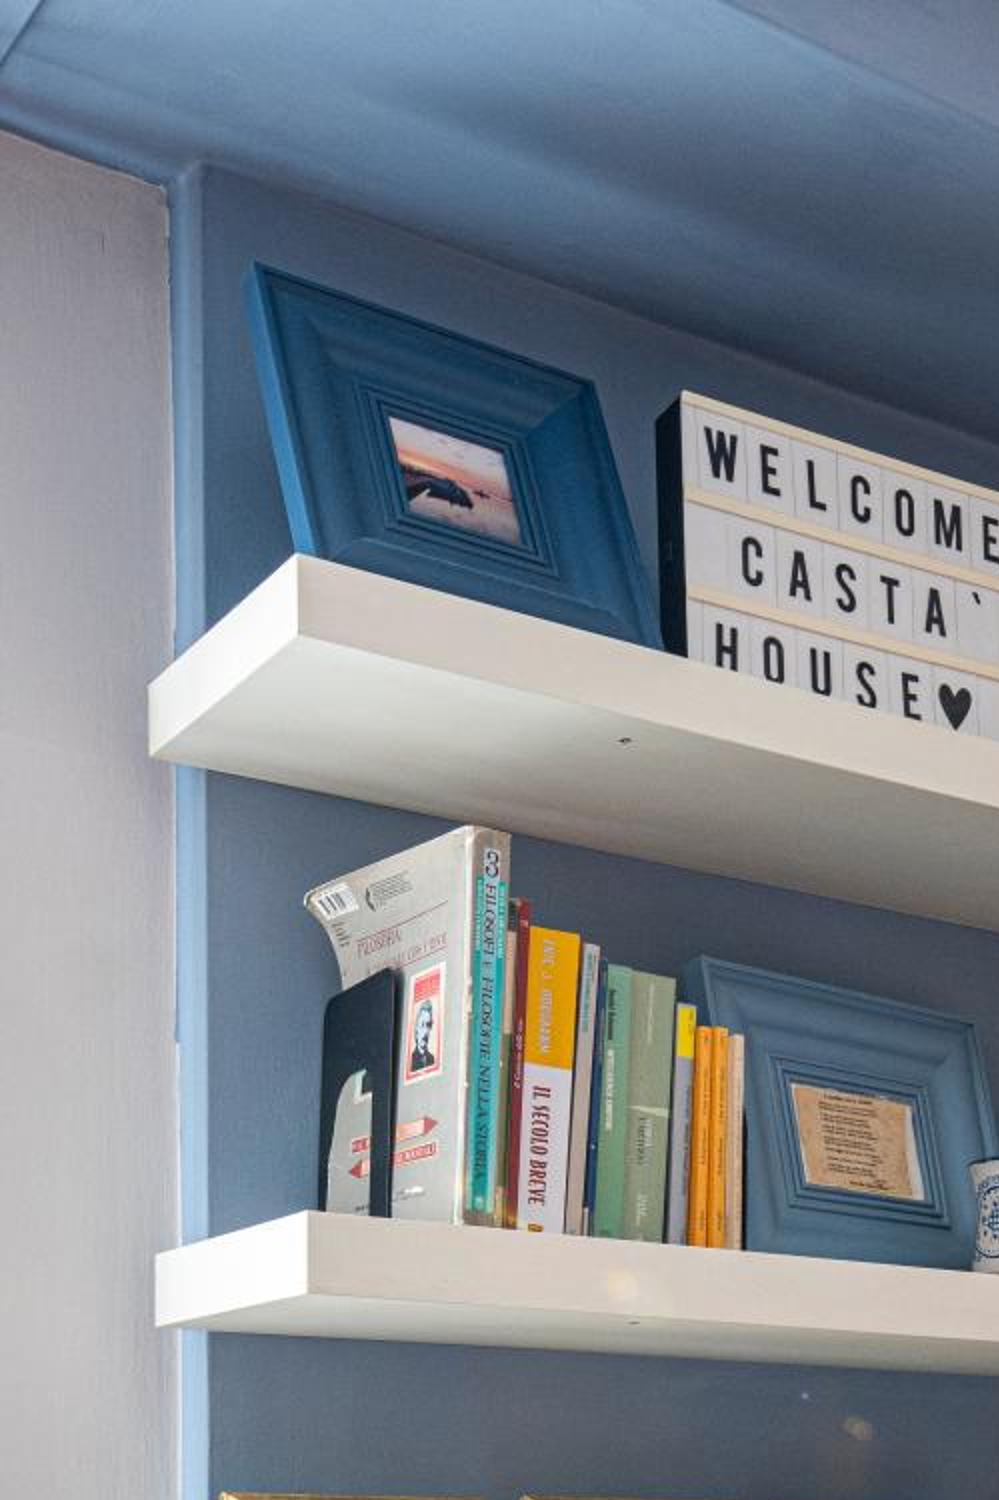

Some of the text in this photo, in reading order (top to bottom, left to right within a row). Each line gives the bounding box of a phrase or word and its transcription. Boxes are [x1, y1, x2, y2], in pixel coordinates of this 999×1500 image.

[715, 622, 922, 721] HOUSE
[528, 1085, 551, 1206] IL SECOLO BREVE
